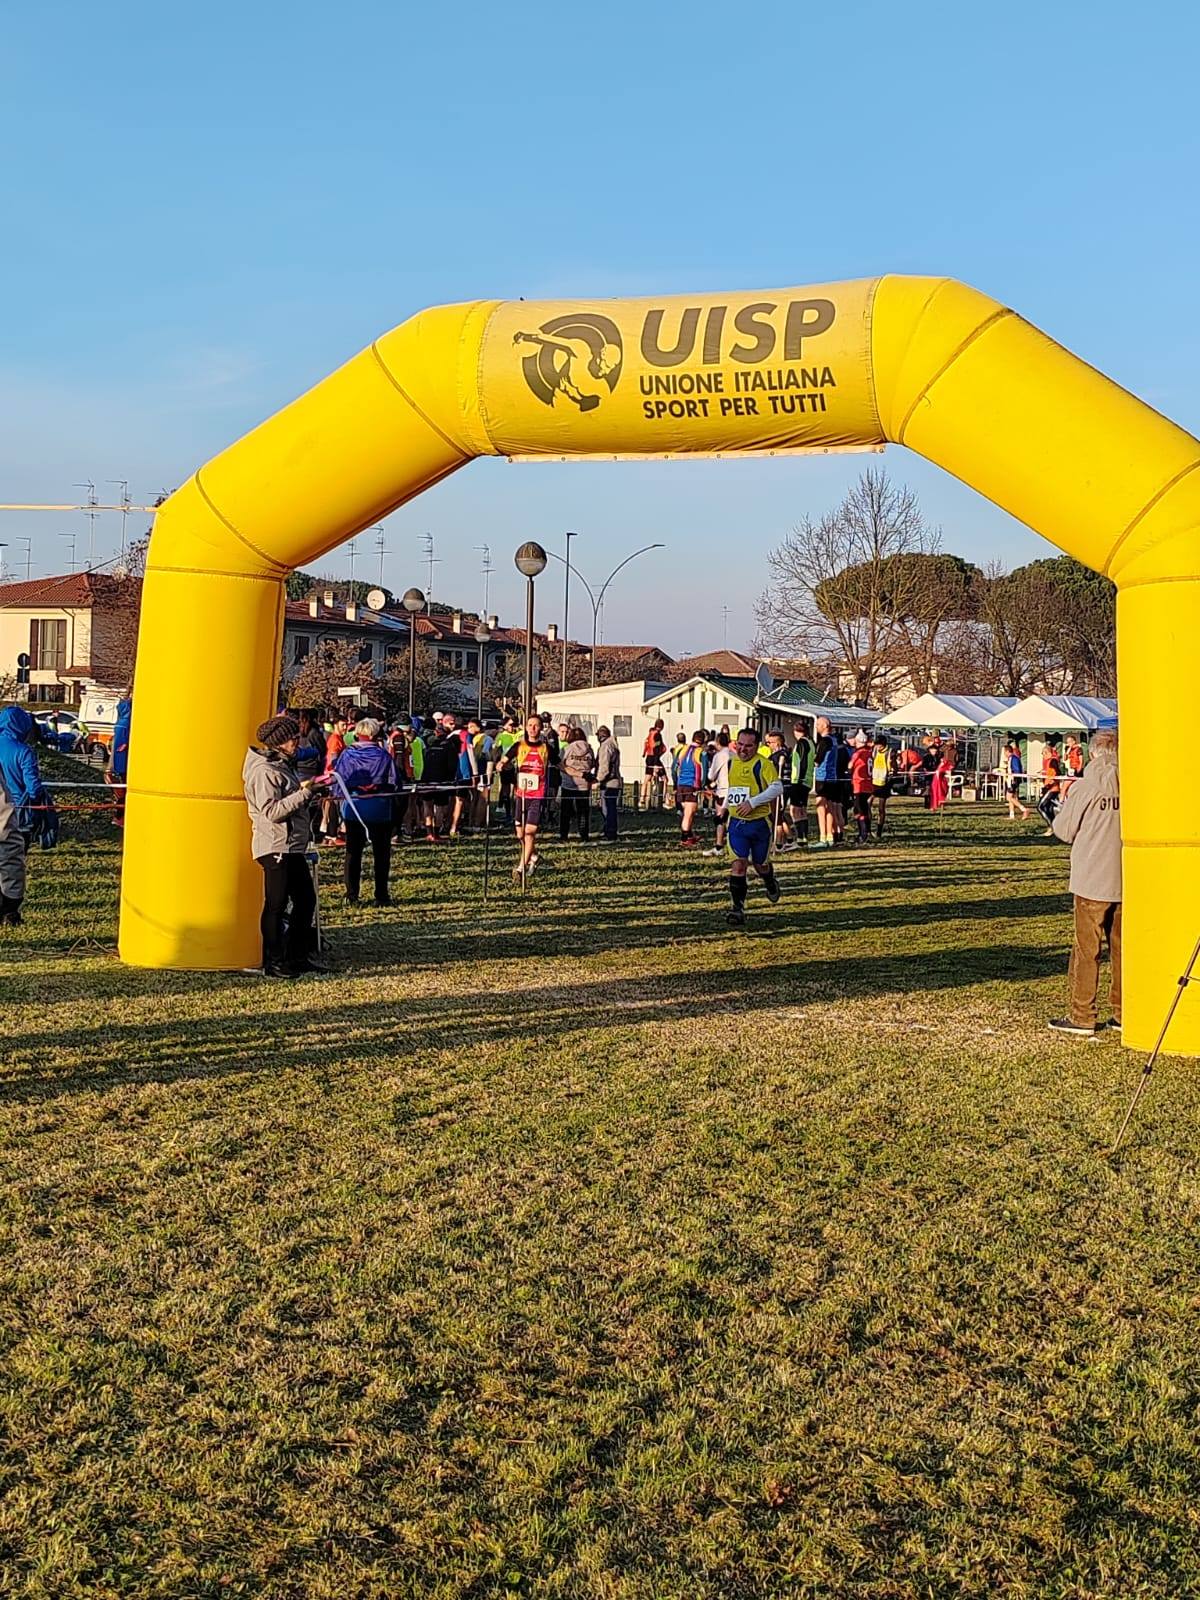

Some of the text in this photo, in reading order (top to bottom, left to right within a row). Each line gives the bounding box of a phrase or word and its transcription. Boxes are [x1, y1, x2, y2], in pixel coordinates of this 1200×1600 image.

[640, 298, 836, 368] UISP
[639, 366, 837, 396] UNIONE ITALIANA
[642, 393, 827, 419] SPORT PER TUTTI
[728, 793, 747, 804] 207
[1100, 797, 1120, 811] GIU
